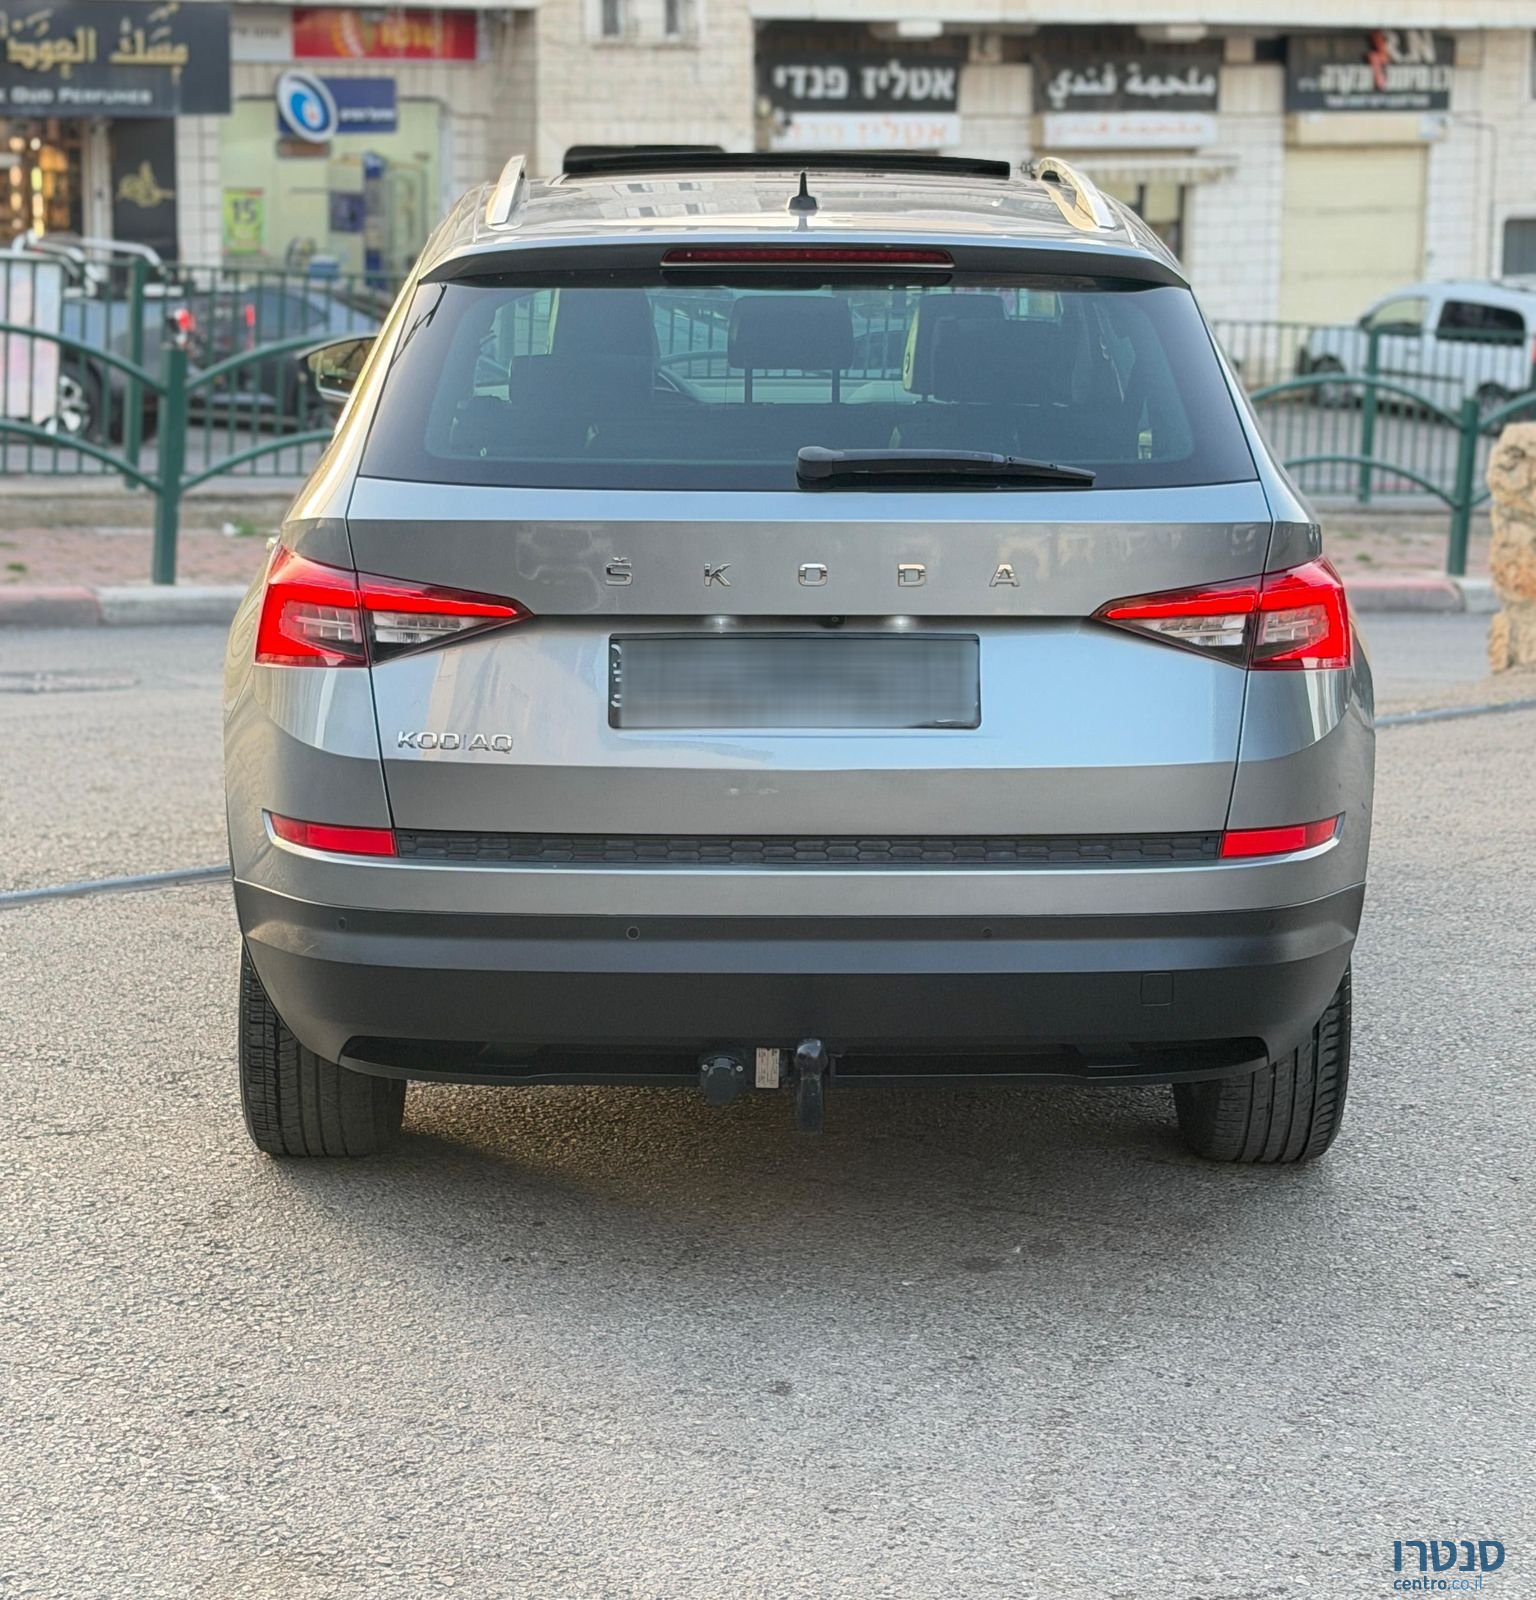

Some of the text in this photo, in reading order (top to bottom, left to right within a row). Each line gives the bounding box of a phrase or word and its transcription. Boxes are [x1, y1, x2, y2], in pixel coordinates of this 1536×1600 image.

[773, 58, 956, 99] אטליז פנדי
[1048, 62, 1217, 109] ملحمة فندي
[397, 731, 513, 754] KODIAQ
